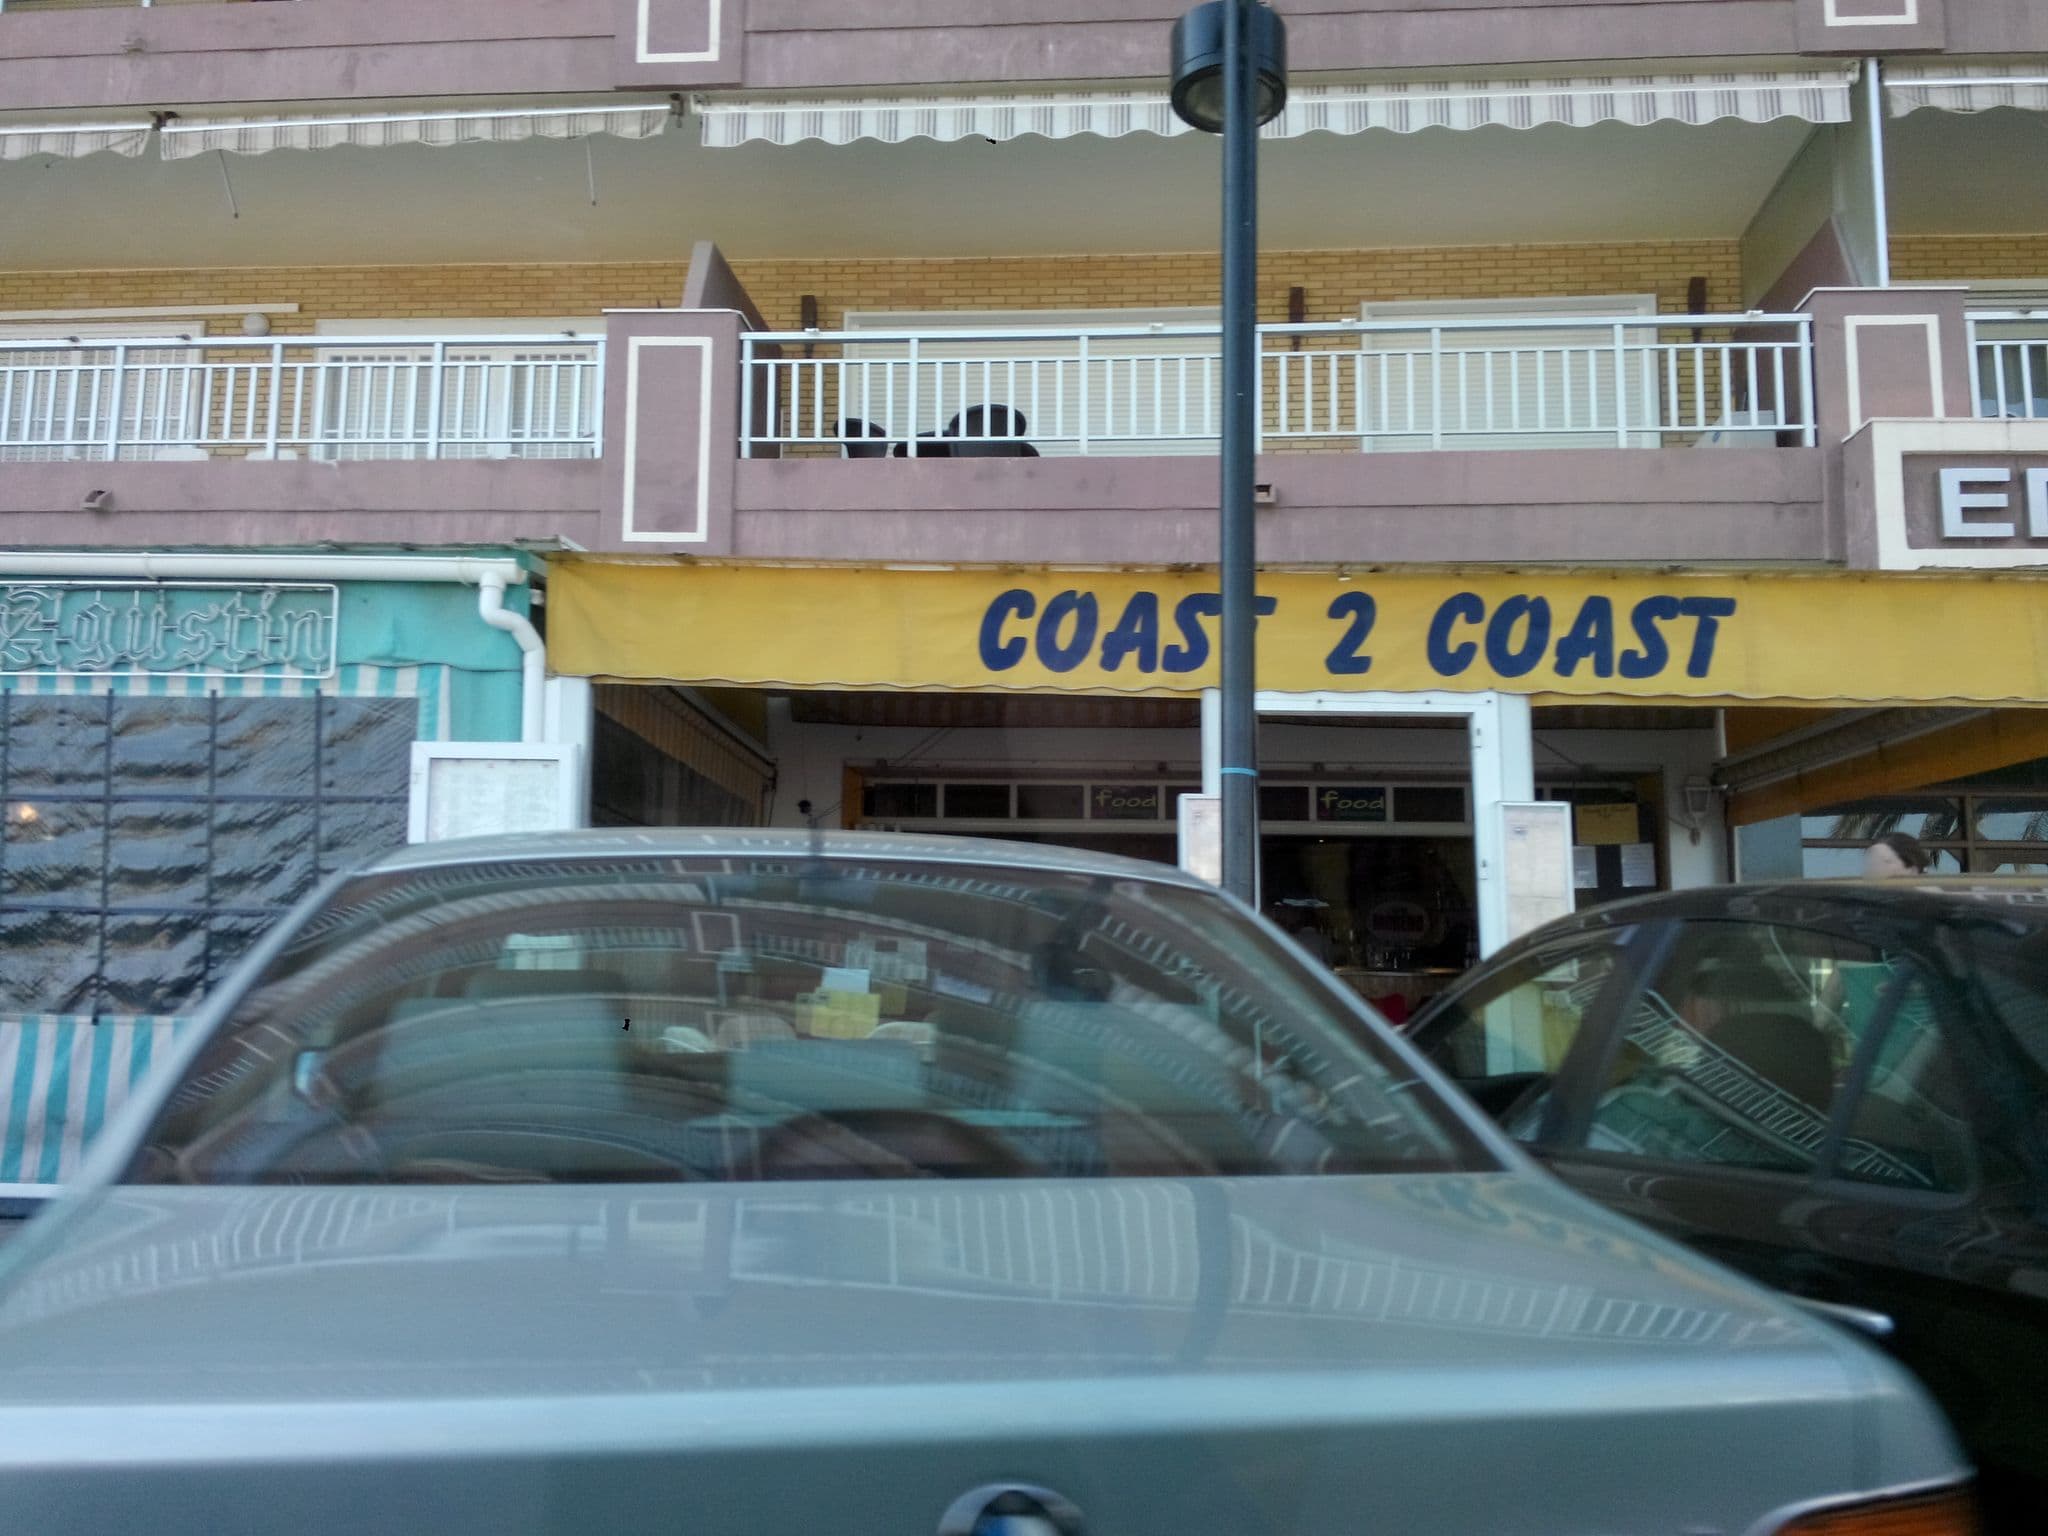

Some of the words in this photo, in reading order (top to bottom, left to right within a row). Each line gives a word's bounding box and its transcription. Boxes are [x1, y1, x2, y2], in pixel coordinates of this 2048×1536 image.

[979, 589, 1278, 674] COAS
[1324, 591, 1376, 674] 2
[1427, 592, 1737, 679] COAST
[1096, 788, 1156, 808] food
[1320, 790, 1384, 809] food
